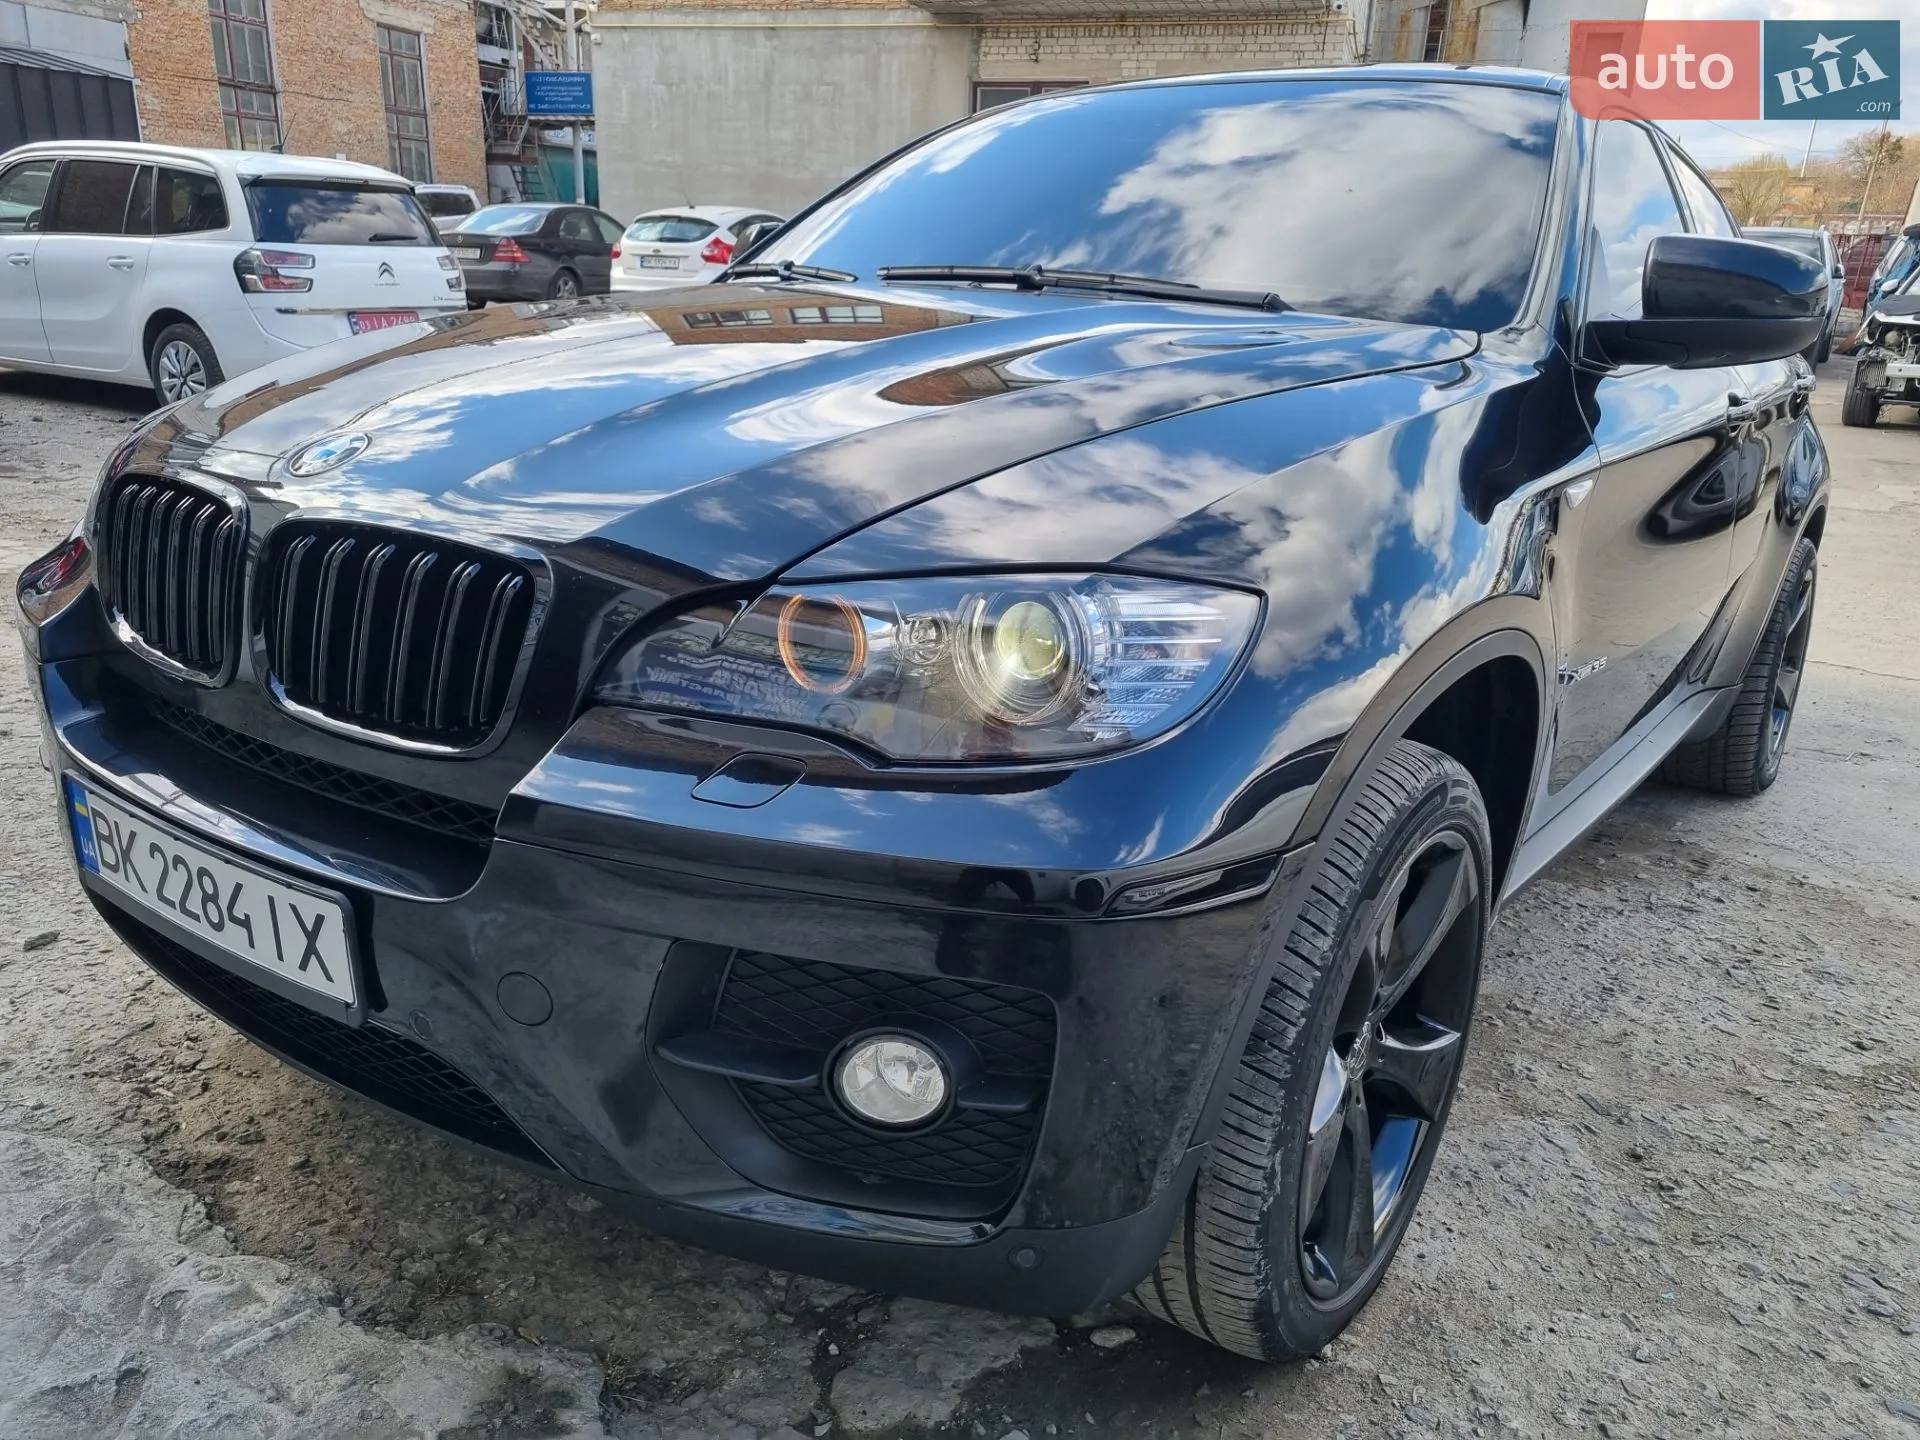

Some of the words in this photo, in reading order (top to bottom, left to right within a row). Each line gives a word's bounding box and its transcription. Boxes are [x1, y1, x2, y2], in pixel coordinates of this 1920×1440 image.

[359, 319, 371, 330] 03
[81, 838, 97, 858] UA
[90, 805, 148, 894] BK
[149, 841, 256, 950] 2284
[267, 894, 335, 984] IX
